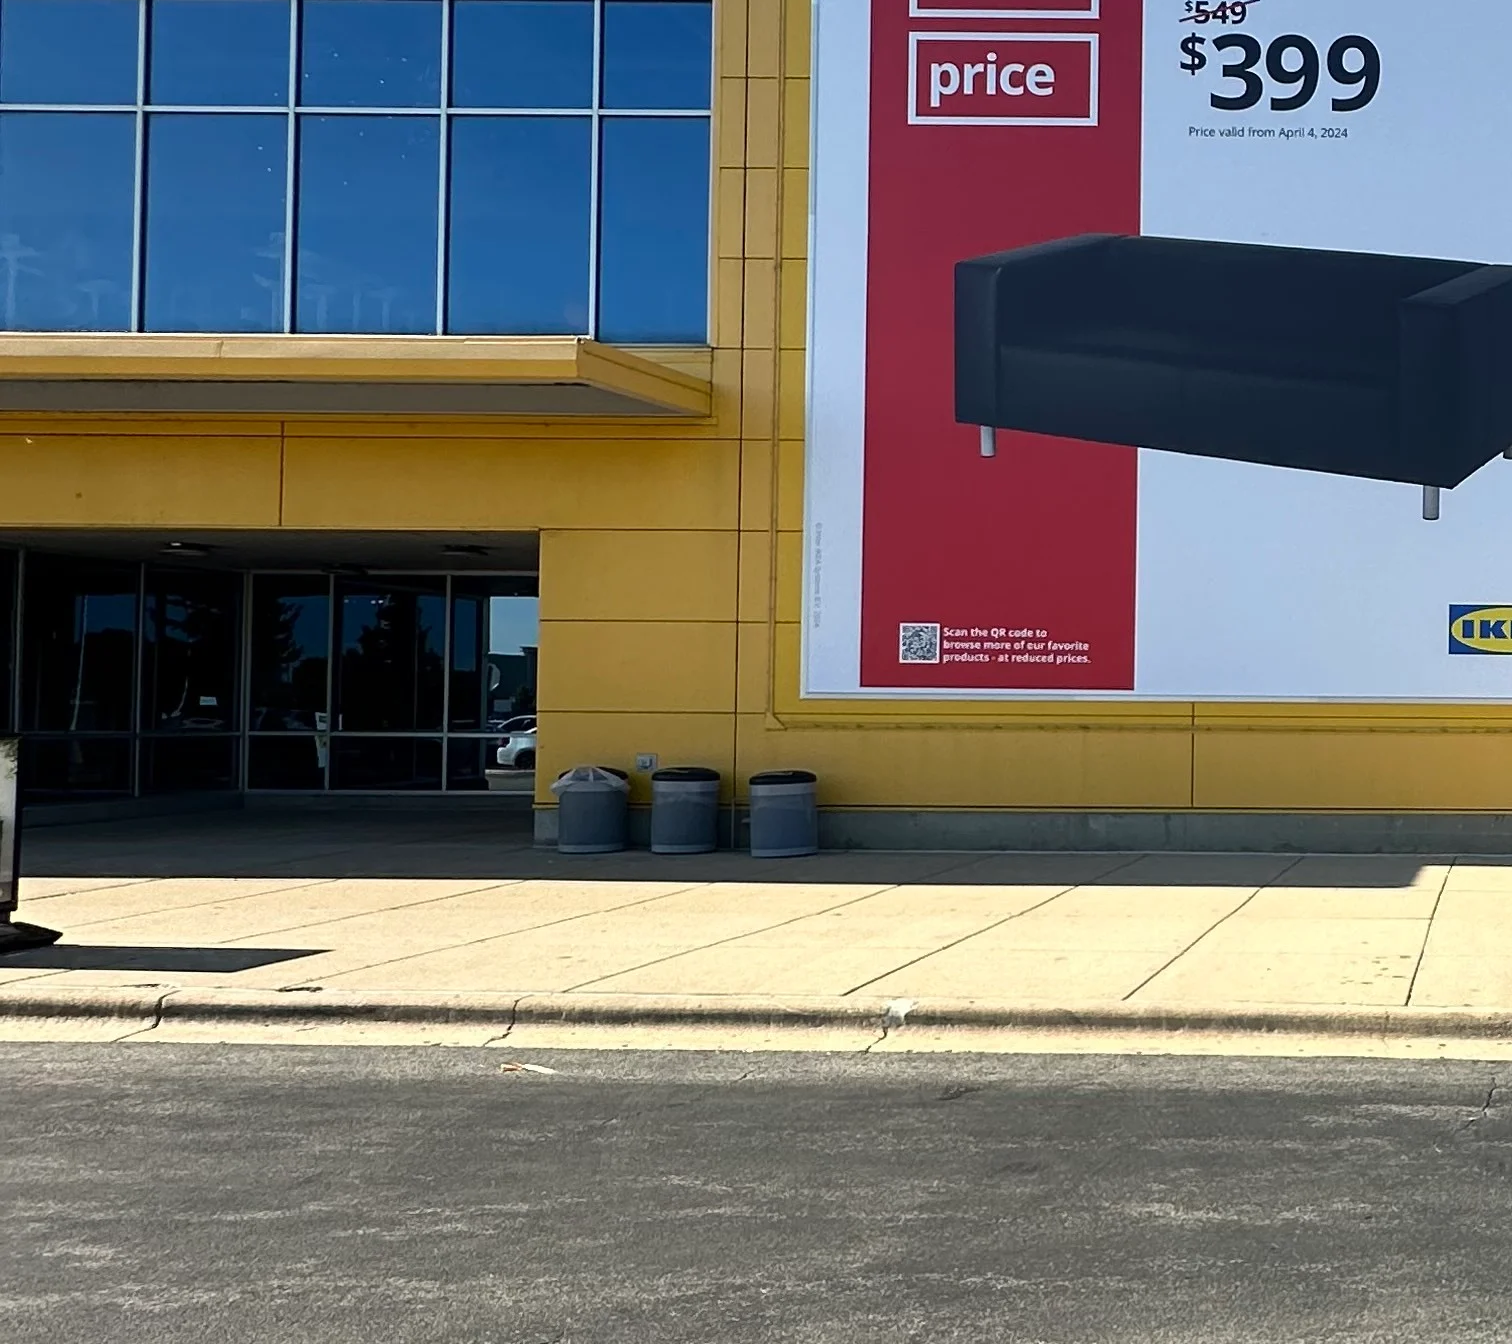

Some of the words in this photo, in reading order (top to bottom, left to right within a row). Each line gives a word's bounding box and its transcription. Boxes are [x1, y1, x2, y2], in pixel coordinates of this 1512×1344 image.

[1184, 0, 1248, 25] $549
[930, 52, 1055, 107] price
[1180, 32, 1381, 112] $399
[1188, 126, 1216, 138] Price
[1219, 126, 1245, 138] valid
[1248, 126, 1275, 138] from
[1278, 127, 1305, 141] April
[1307, 127, 1318, 140] 4,
[1320, 127, 1348, 139] 2024
[943, 627, 968, 638] Scan
[970, 627, 988, 638] the
[990, 628, 1007, 639] QR
[1008, 628, 1034, 638] code
[1035, 629, 1047, 638] to
[943, 640, 981, 650] browse
[983, 641, 1011, 650] more
[1013, 640, 1025, 650] of
[1026, 642, 1045, 650] our
[1047, 640, 1090, 651] favorite
[943, 653, 990, 664] products
[997, 654, 1009, 664] at
[1011, 653, 1054, 664] reduced
[1056, 654, 1092, 665] prices.
